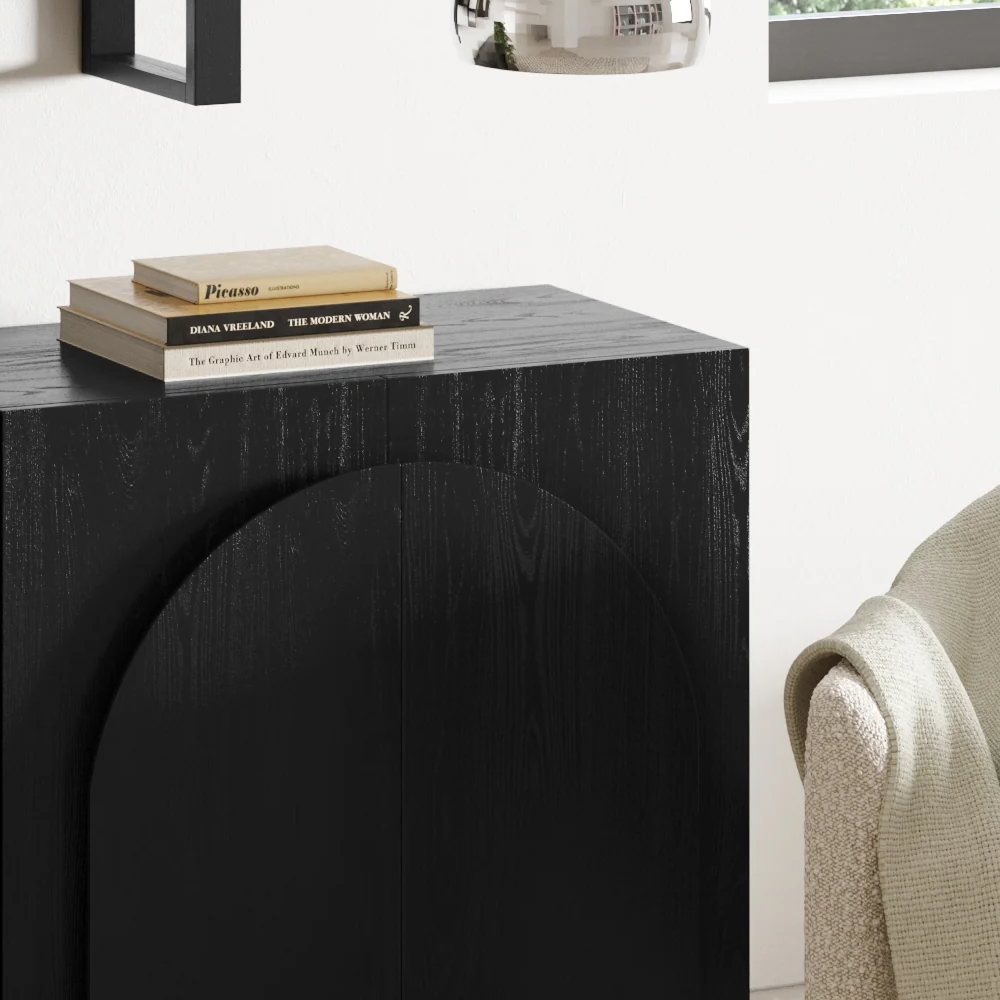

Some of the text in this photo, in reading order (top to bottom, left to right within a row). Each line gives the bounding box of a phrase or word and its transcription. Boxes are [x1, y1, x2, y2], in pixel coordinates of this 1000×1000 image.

[204, 283, 260, 300] Picasso
[287, 310, 391, 327] THE MODERN WOMAN
[190, 320, 275, 335] DIANA VREELAND
[189, 341, 417, 367] The Graphic Art of Edvard Munch by Werner Timm
